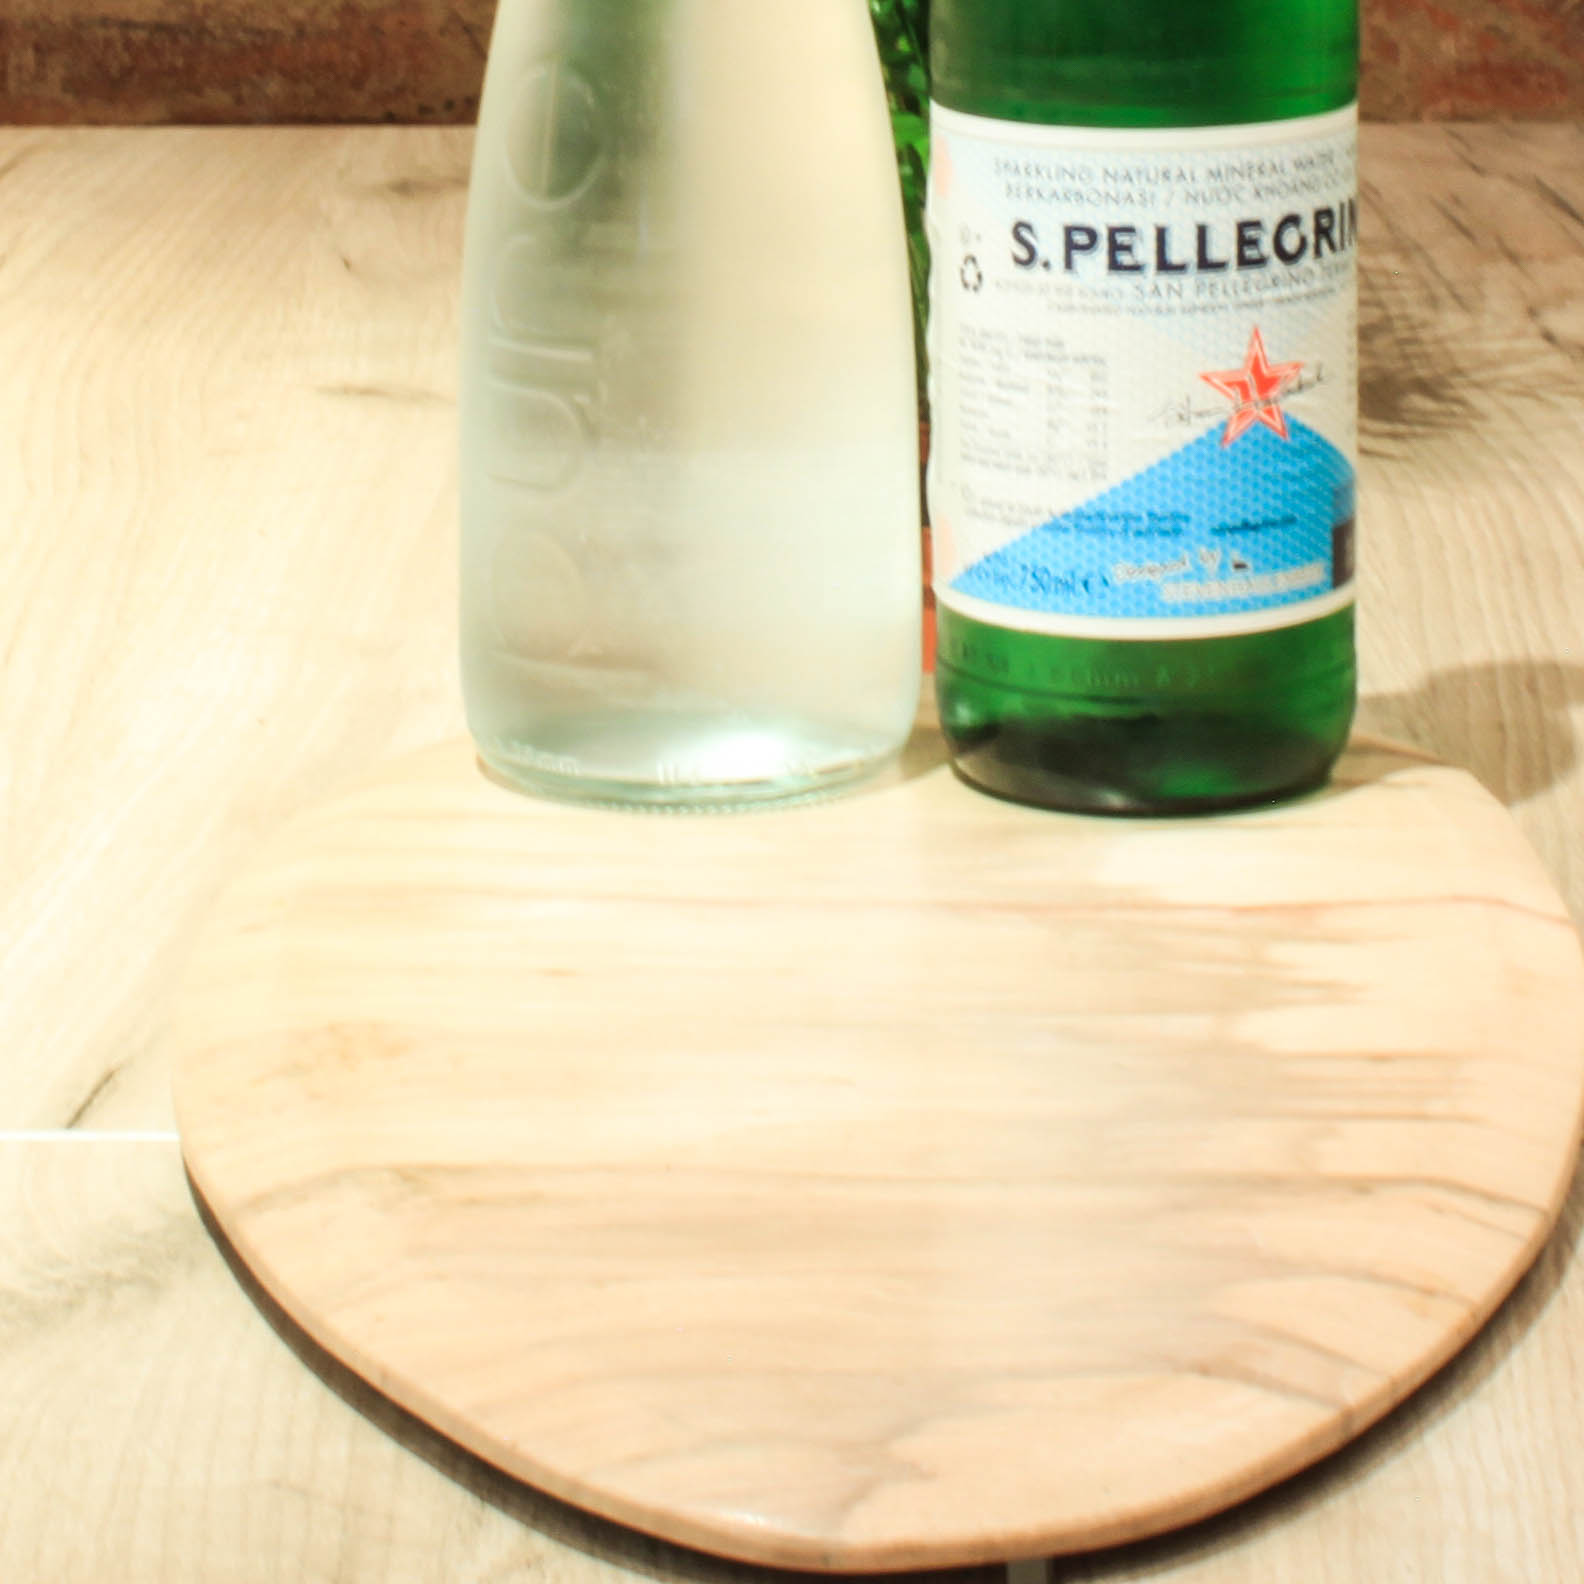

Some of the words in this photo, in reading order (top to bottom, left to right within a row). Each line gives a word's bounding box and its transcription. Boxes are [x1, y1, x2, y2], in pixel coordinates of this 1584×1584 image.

[1101, 165, 1196, 186] NATURAL
[1205, 159, 1287, 184] MINERAL
[1133, 280, 1186, 299] SAN
[1195, 266, 1315, 299] PELLEGRINO
